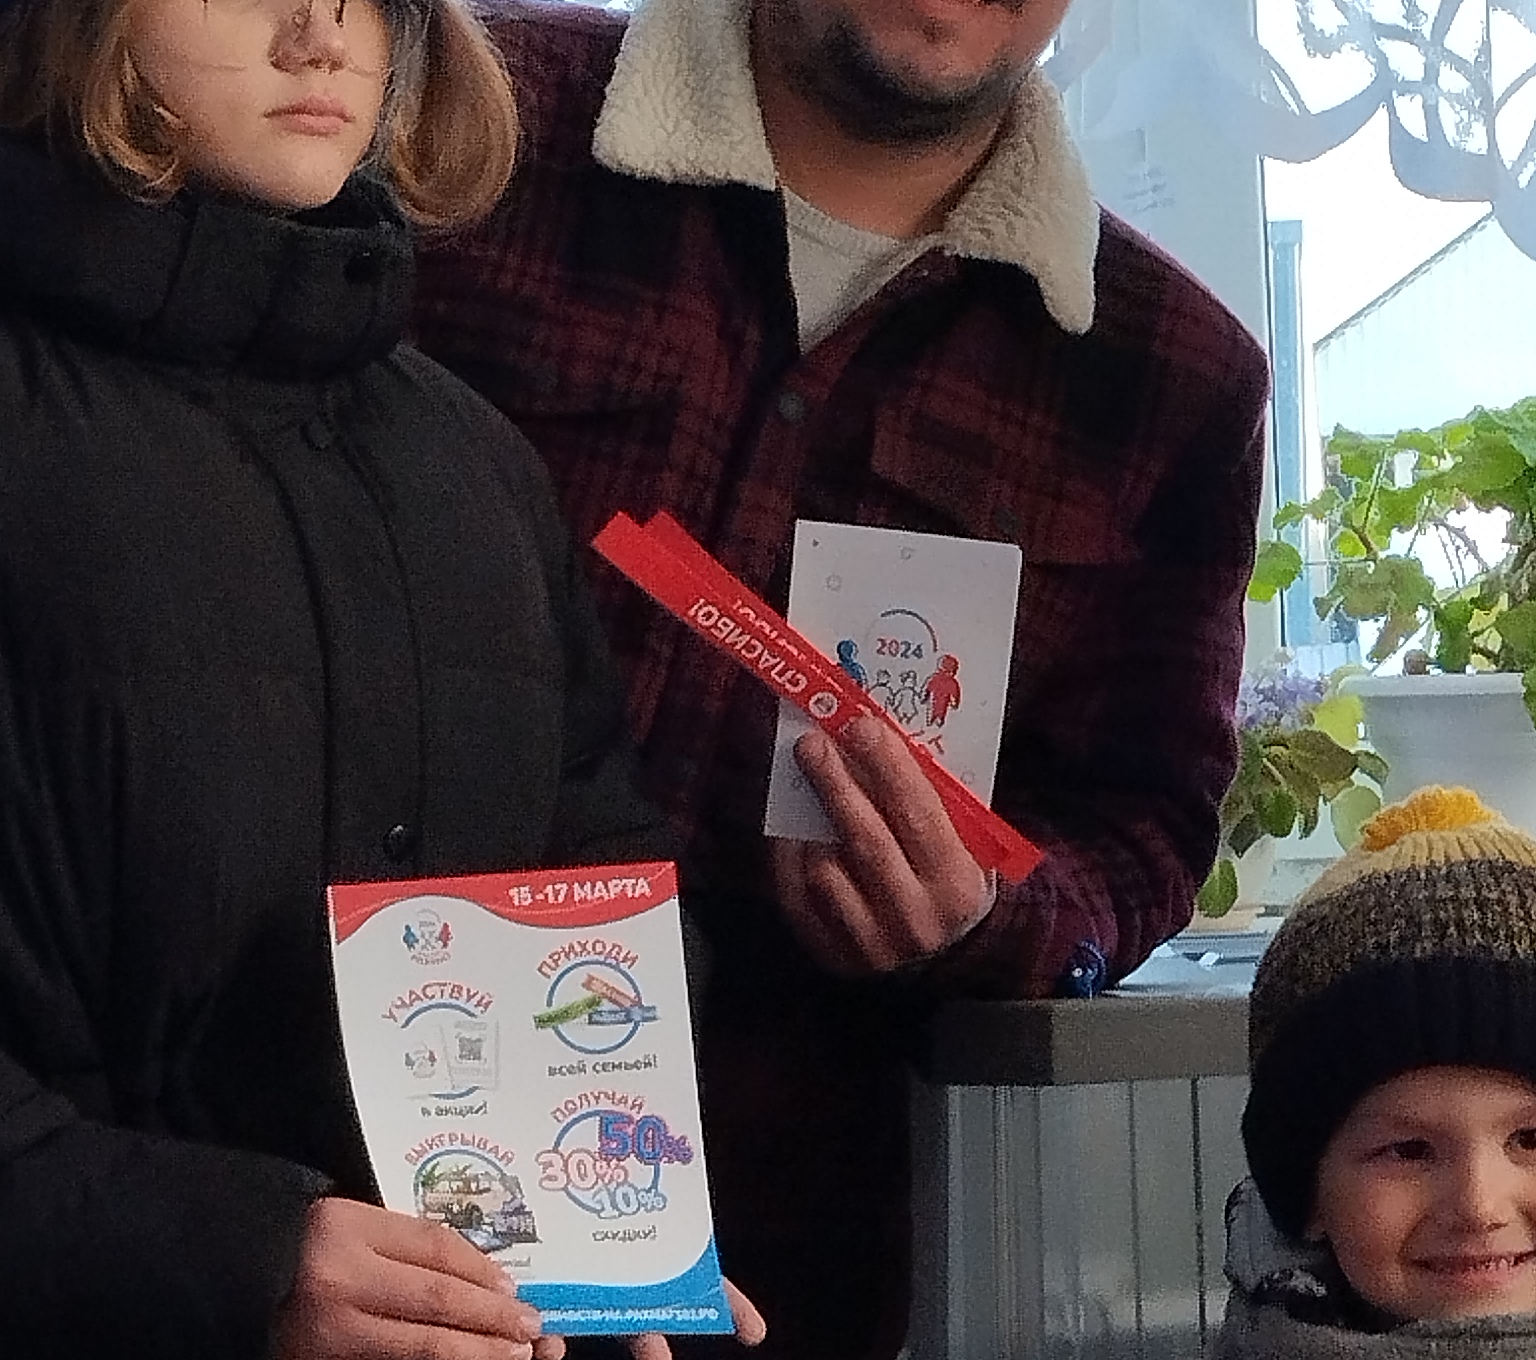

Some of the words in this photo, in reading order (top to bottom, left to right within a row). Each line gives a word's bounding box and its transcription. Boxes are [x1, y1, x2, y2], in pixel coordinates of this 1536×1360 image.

[688, 598, 808, 693] СПАСИБО!
[876, 638, 924, 659] 2024
[573, 877, 652, 902] МАРТА
[536, 939, 639, 978] ПРИХОДИ
[381, 981, 494, 1022] УЧАСТВУЙ
[548, 1059, 587, 1077] всей
[550, 1090, 645, 1124] ПОЛУЧАЙ
[404, 1131, 515, 1166] ВЫИГРЫВАЙ
[600, 1109, 694, 1165] 50%
[535, 1147, 629, 1191] 30%
[593, 1183, 667, 1219] 10%
